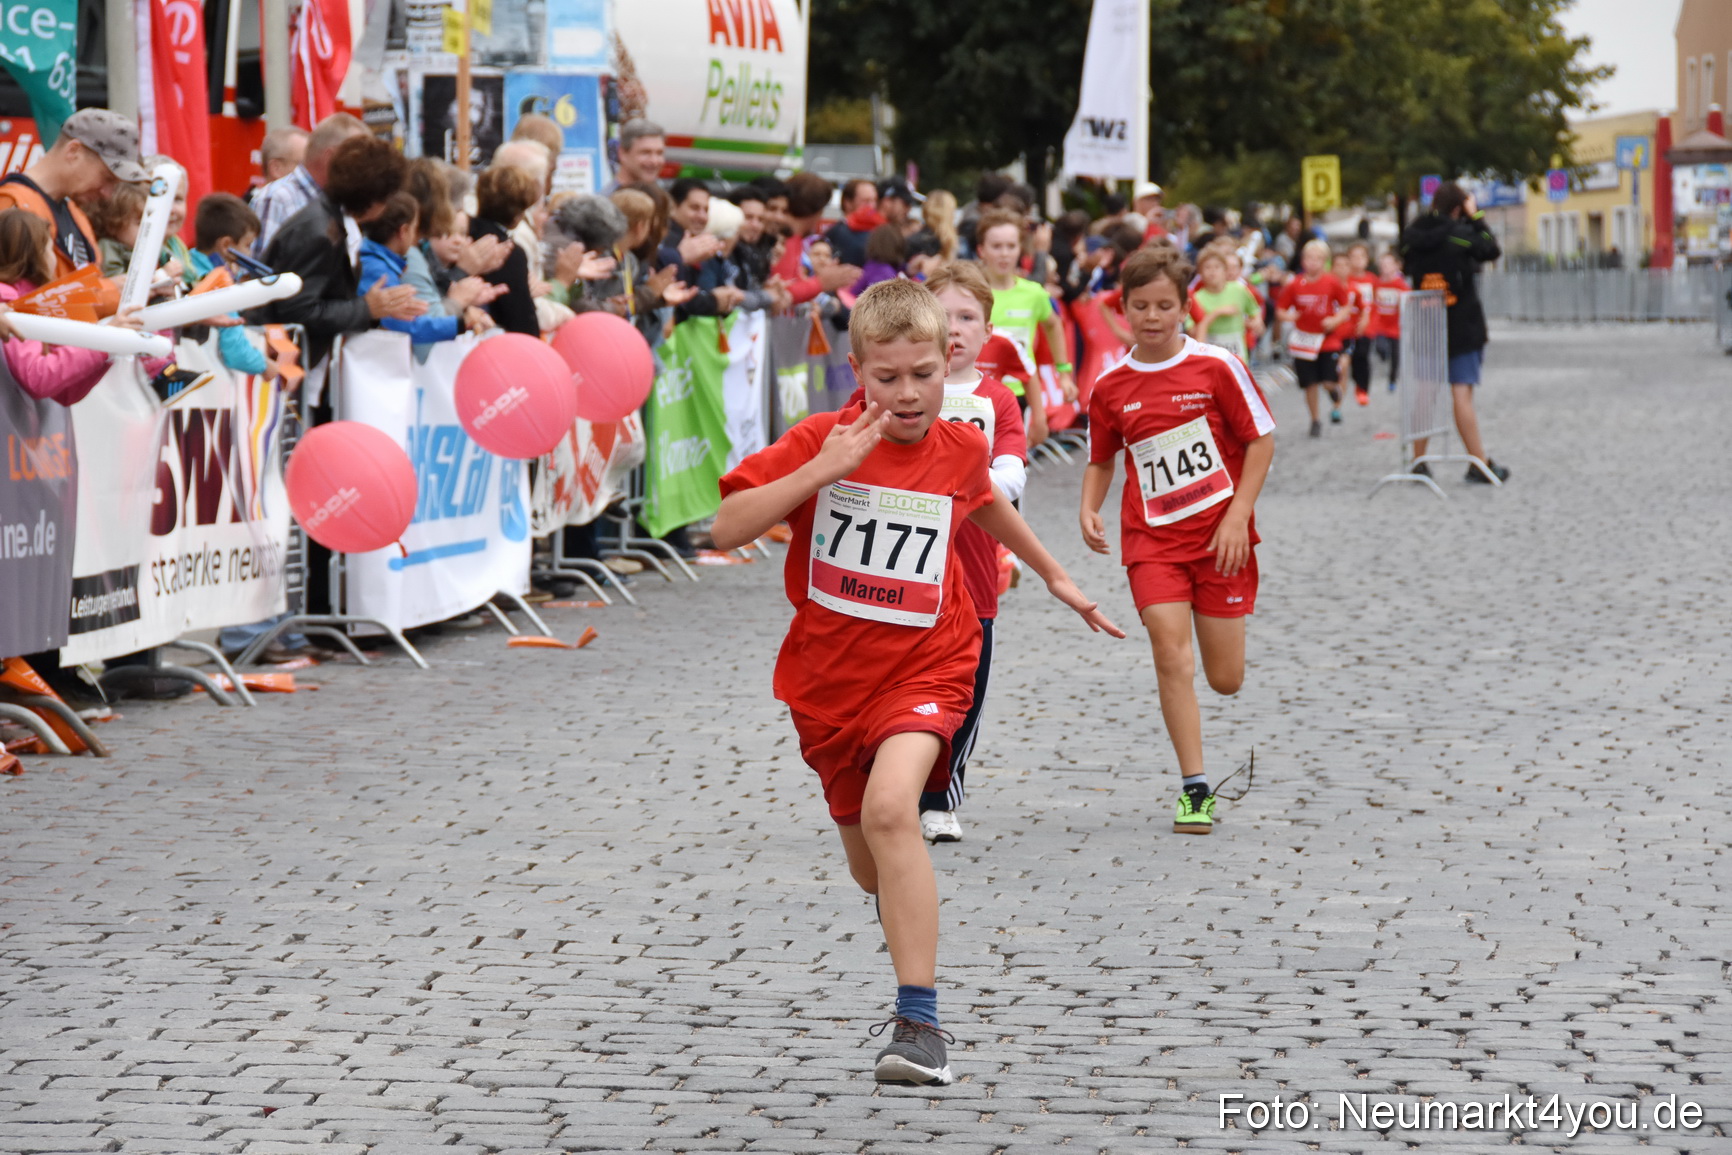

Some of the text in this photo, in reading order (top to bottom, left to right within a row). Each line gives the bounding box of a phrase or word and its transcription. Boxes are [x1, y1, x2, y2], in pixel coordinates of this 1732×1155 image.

[706, 0, 783, 52] AVIA
[701, 58, 782, 129] Pellets
[1313, 172, 1331, 198] D
[1123, 401, 1142, 413] JAKO
[1157, 423, 1201, 448] BOCK
[1143, 441, 1213, 492] 7143
[829, 490, 870, 507] NeuerMarkt
[879, 492, 941, 515] BOCK
[1161, 482, 1213, 512] Johannes
[815, 548, 821, 558] 6
[828, 509, 939, 574] 7177
[840, 576, 904, 605] Marcel
[933, 572, 939, 583] K
